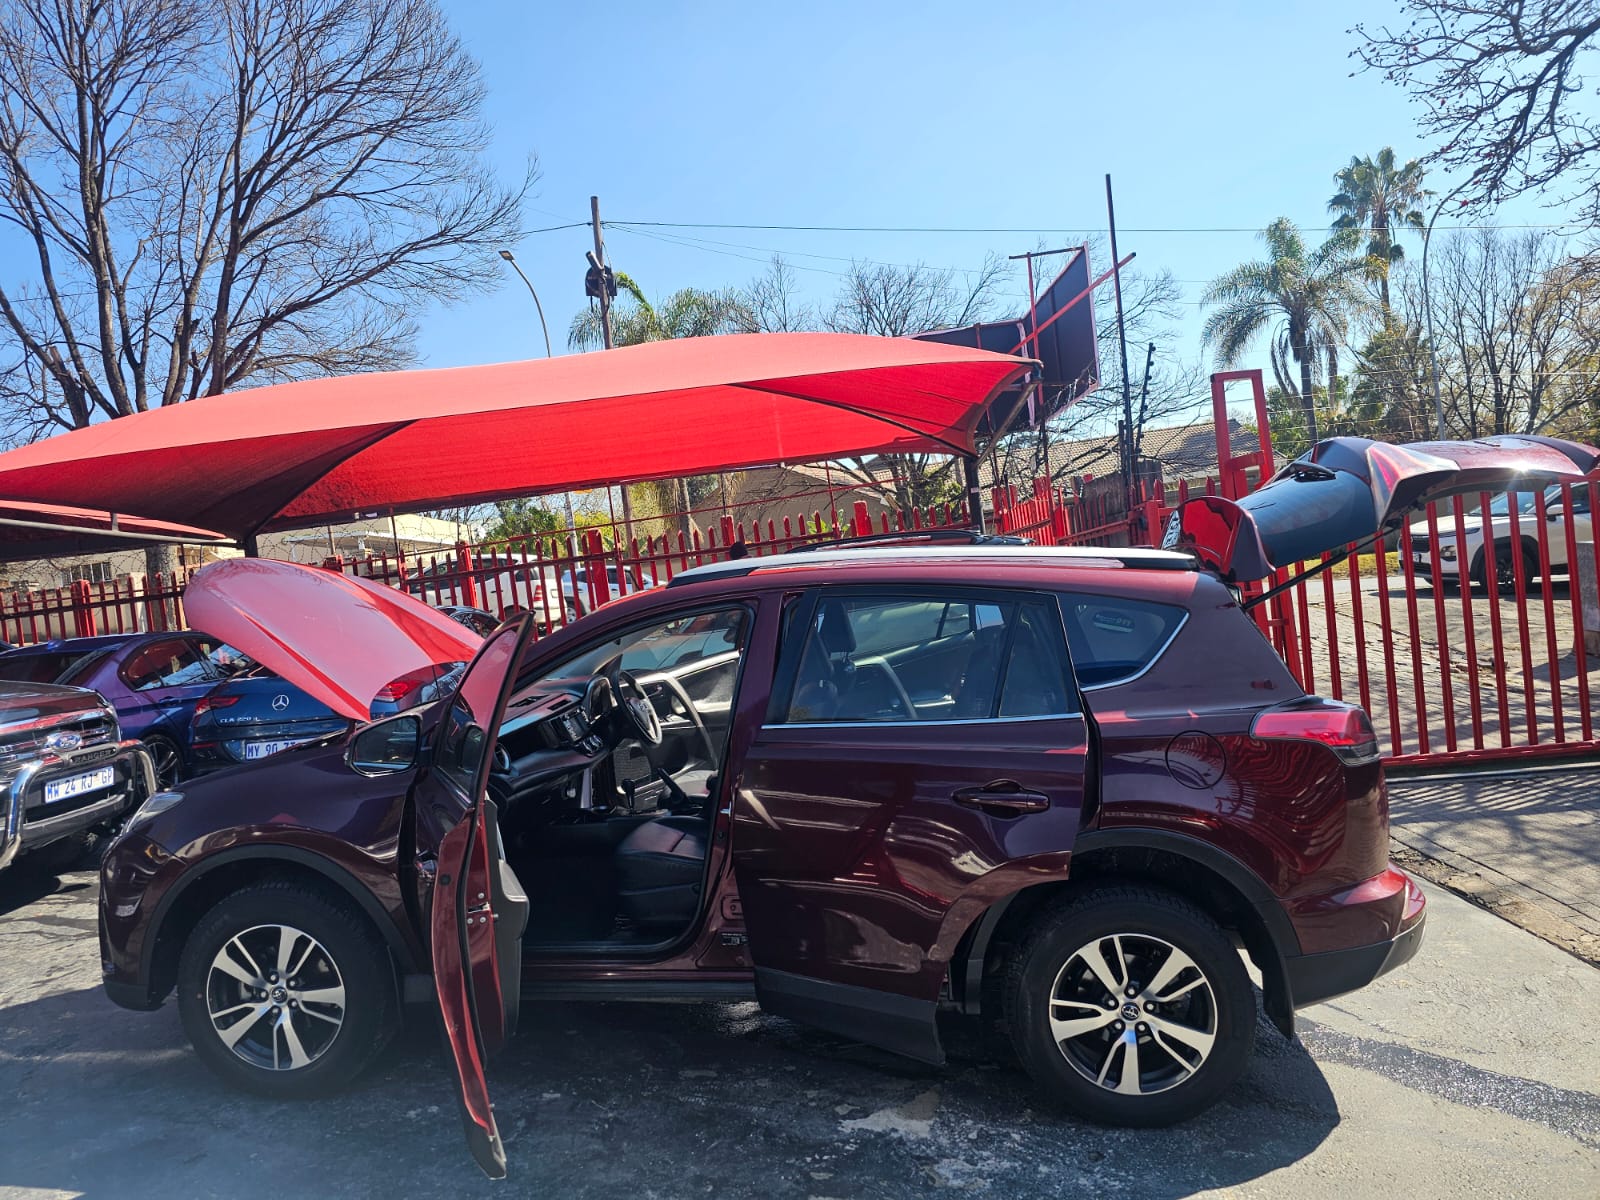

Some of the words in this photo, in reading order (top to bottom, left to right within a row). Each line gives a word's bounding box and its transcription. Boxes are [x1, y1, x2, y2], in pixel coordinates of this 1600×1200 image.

[74, 749, 112, 763] RANGER
[247, 744, 260, 757] MY
[65, 777, 76, 795] 24
[81, 774, 93, 791] RJ
[101, 767, 113, 785] GP
